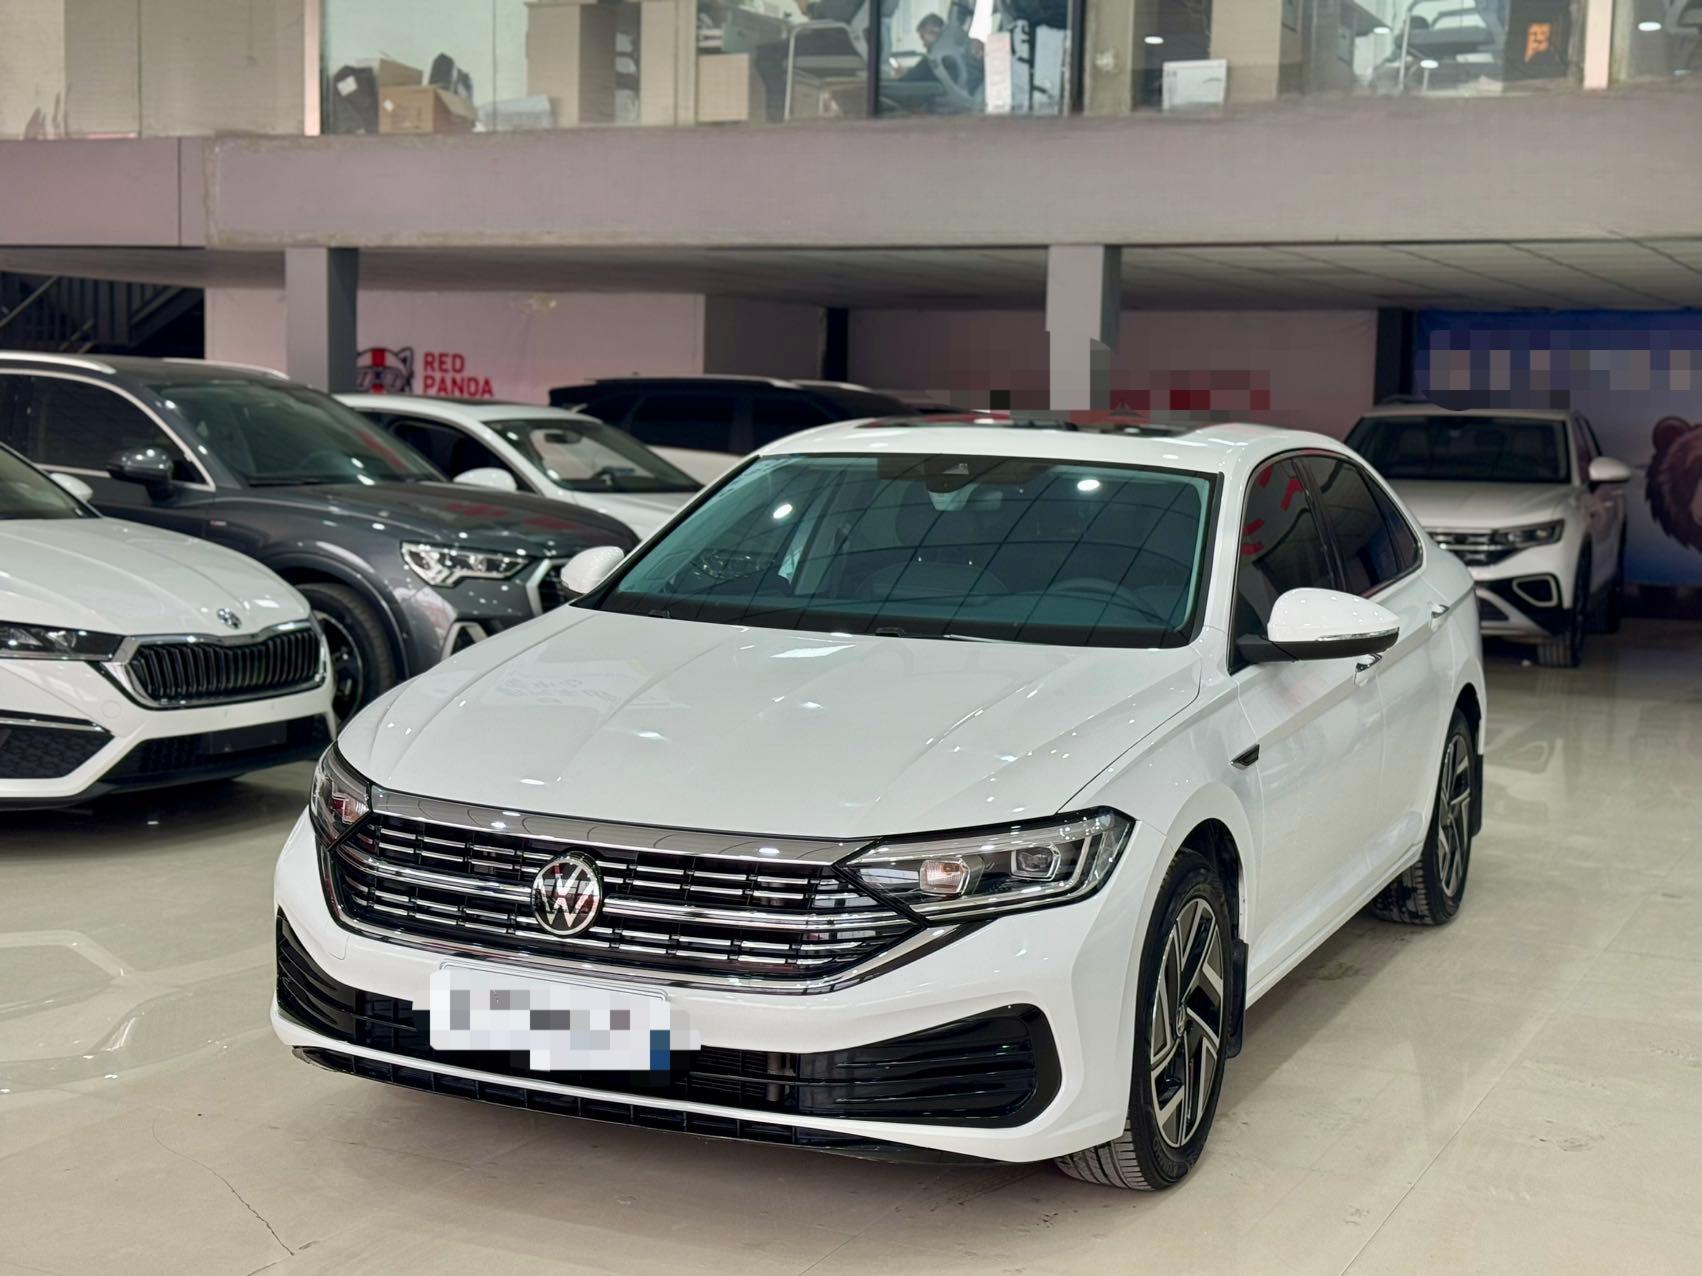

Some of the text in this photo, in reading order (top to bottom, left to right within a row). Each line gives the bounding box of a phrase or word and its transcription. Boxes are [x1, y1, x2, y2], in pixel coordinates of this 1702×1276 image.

[424, 352, 465, 373] RED
[424, 375, 494, 398] PANDA
[532, 855, 600, 936] VW
